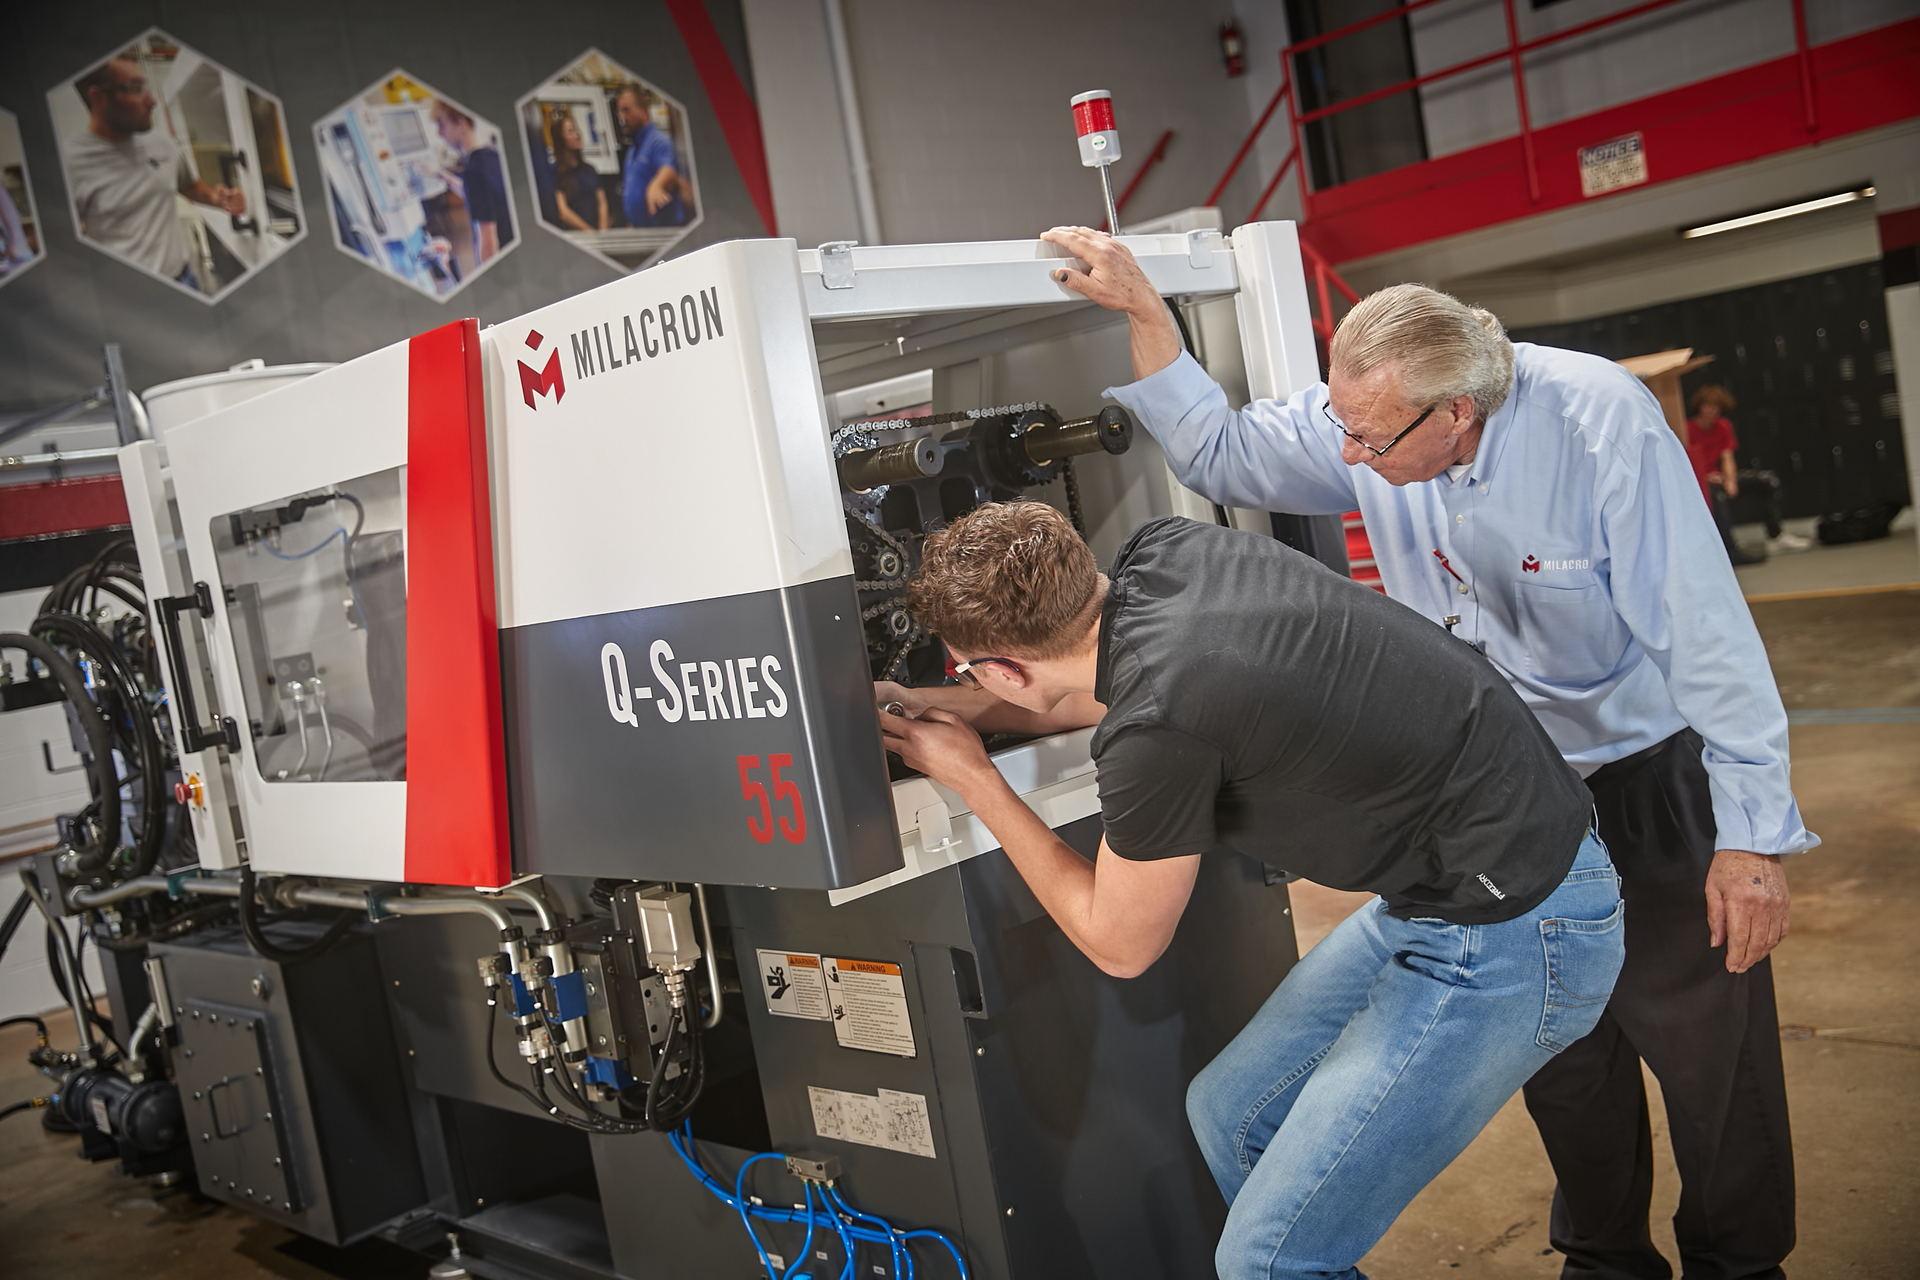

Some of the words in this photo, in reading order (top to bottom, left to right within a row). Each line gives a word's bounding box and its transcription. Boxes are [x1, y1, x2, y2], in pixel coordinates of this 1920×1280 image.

[571, 286, 724, 379] MILACRON
[1543, 559, 1589, 571] MILACRO
[736, 753, 807, 844] 55
[857, 963, 886, 973] WARNING
